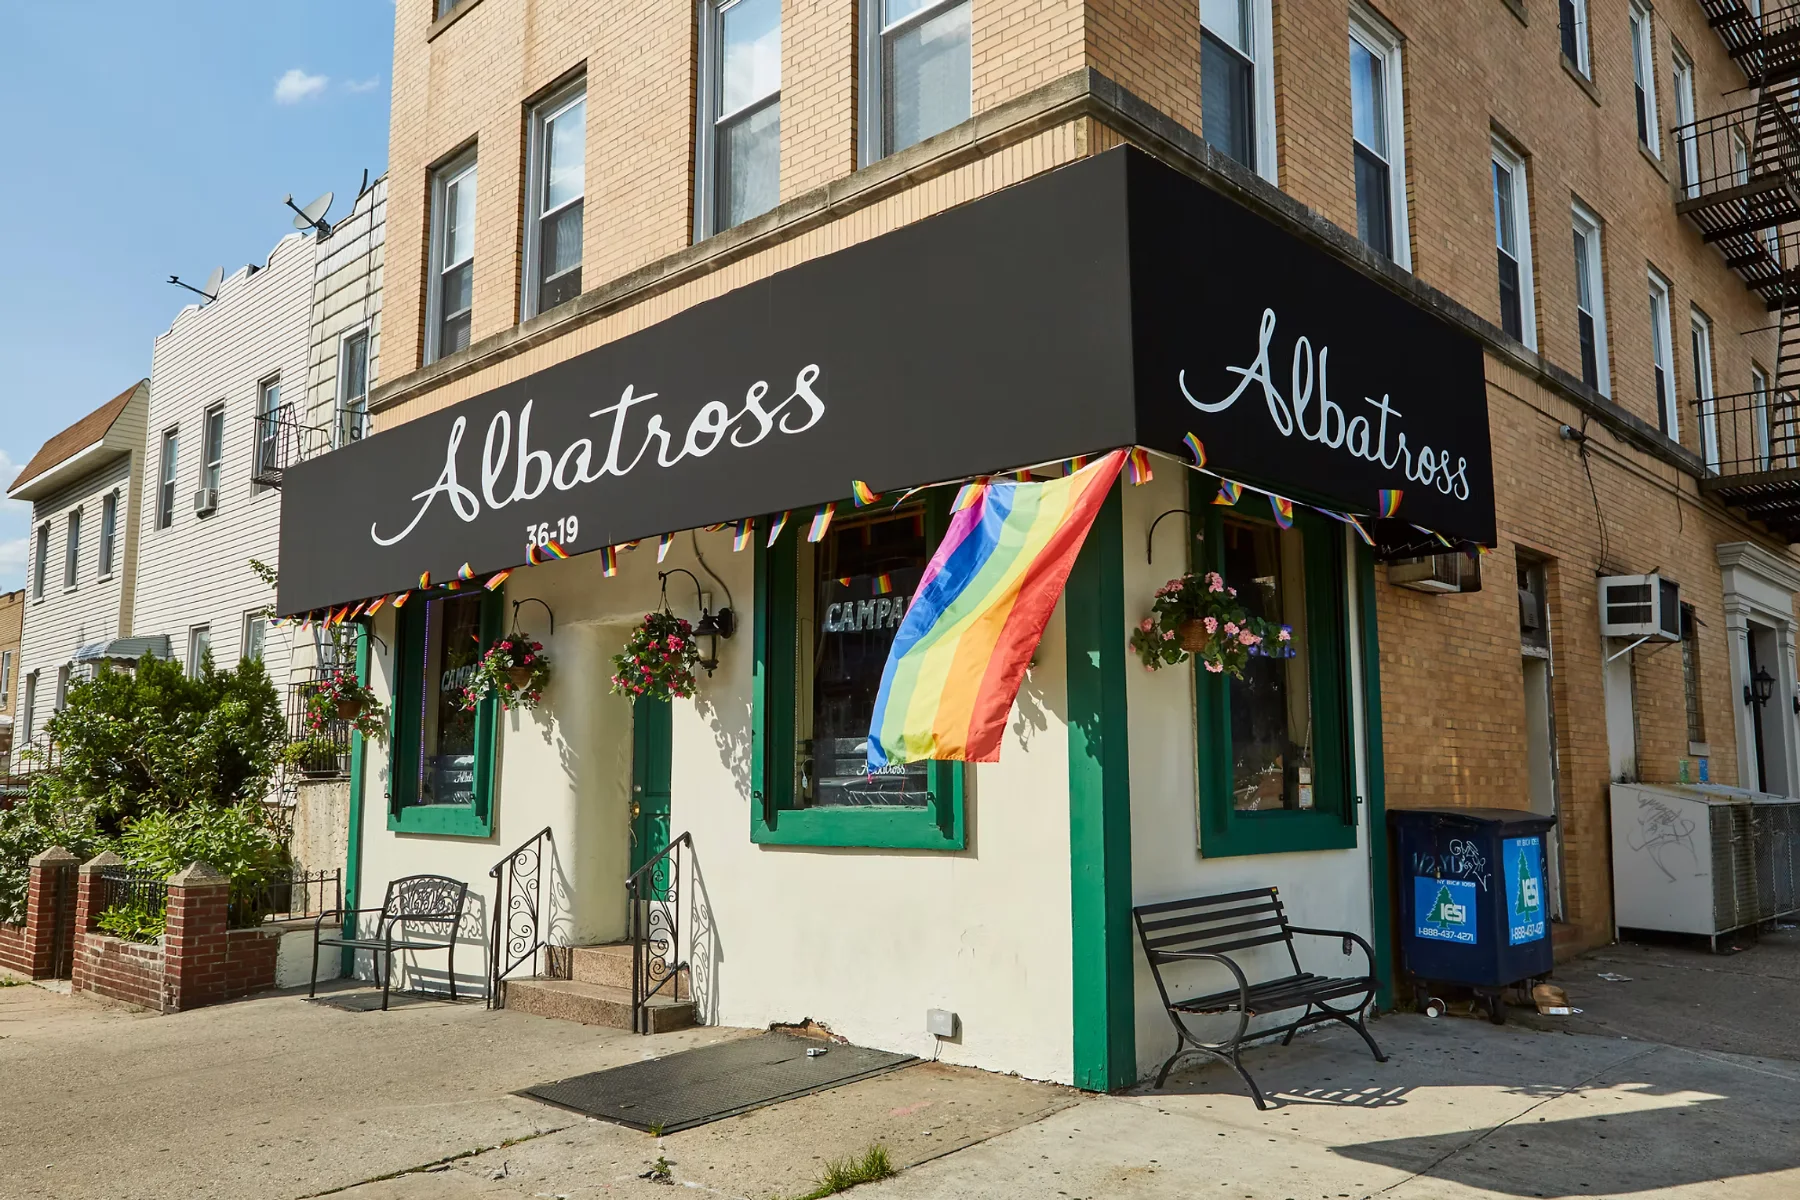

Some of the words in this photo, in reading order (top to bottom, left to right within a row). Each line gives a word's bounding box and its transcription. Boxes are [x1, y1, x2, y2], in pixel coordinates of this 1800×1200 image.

[1179, 308, 1470, 501] Albatross
[371, 364, 826, 546] Albatross
[526, 515, 579, 549] 36-19
[824, 596, 912, 632] CAMPA
[1441, 903, 1466, 922] IESI
[1418, 927, 1474, 942] 1-888-437-4271
